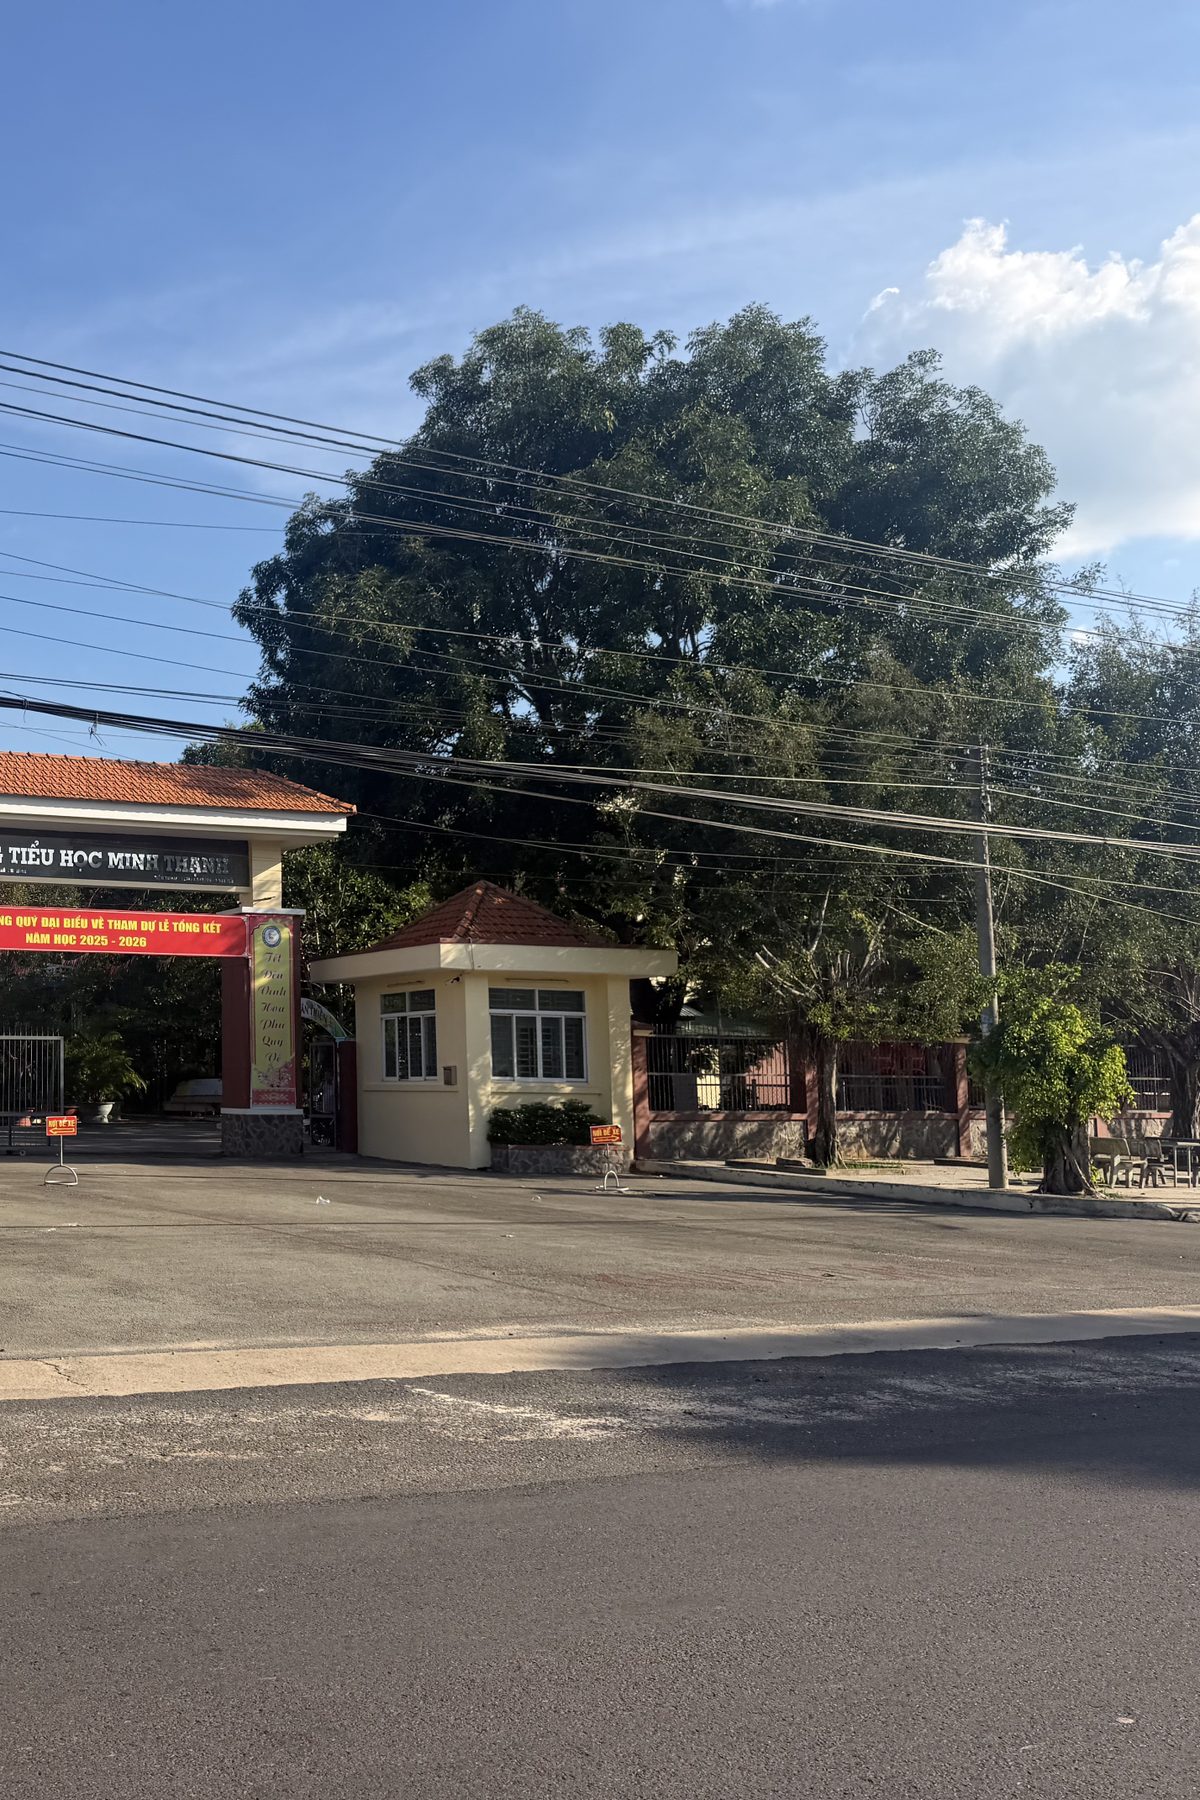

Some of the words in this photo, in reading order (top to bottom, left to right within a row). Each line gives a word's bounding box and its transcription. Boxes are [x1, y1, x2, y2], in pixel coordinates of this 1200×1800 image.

[8, 840, 54, 866] TIỂU
[59, 850, 103, 872] HỌC
[107, 852, 159, 871] MINH
[164, 855, 229, 877] THẠNH
[41, 917, 60, 929] ĐẠI
[63, 915, 89, 929] BIỂU
[91, 916, 105, 930] VỀ
[107, 919, 138, 931] THAM
[140, 920, 157, 933] DỰ
[158, 918, 170, 932] LỄ
[172, 919, 200, 933] TỔNG
[203, 920, 222, 934] KẾT
[25, 932, 51, 945] NĂM
[53, 933, 77, 947] HỌC
[79, 935, 109, 946] 2025
[118, 936, 147, 948] 2026
